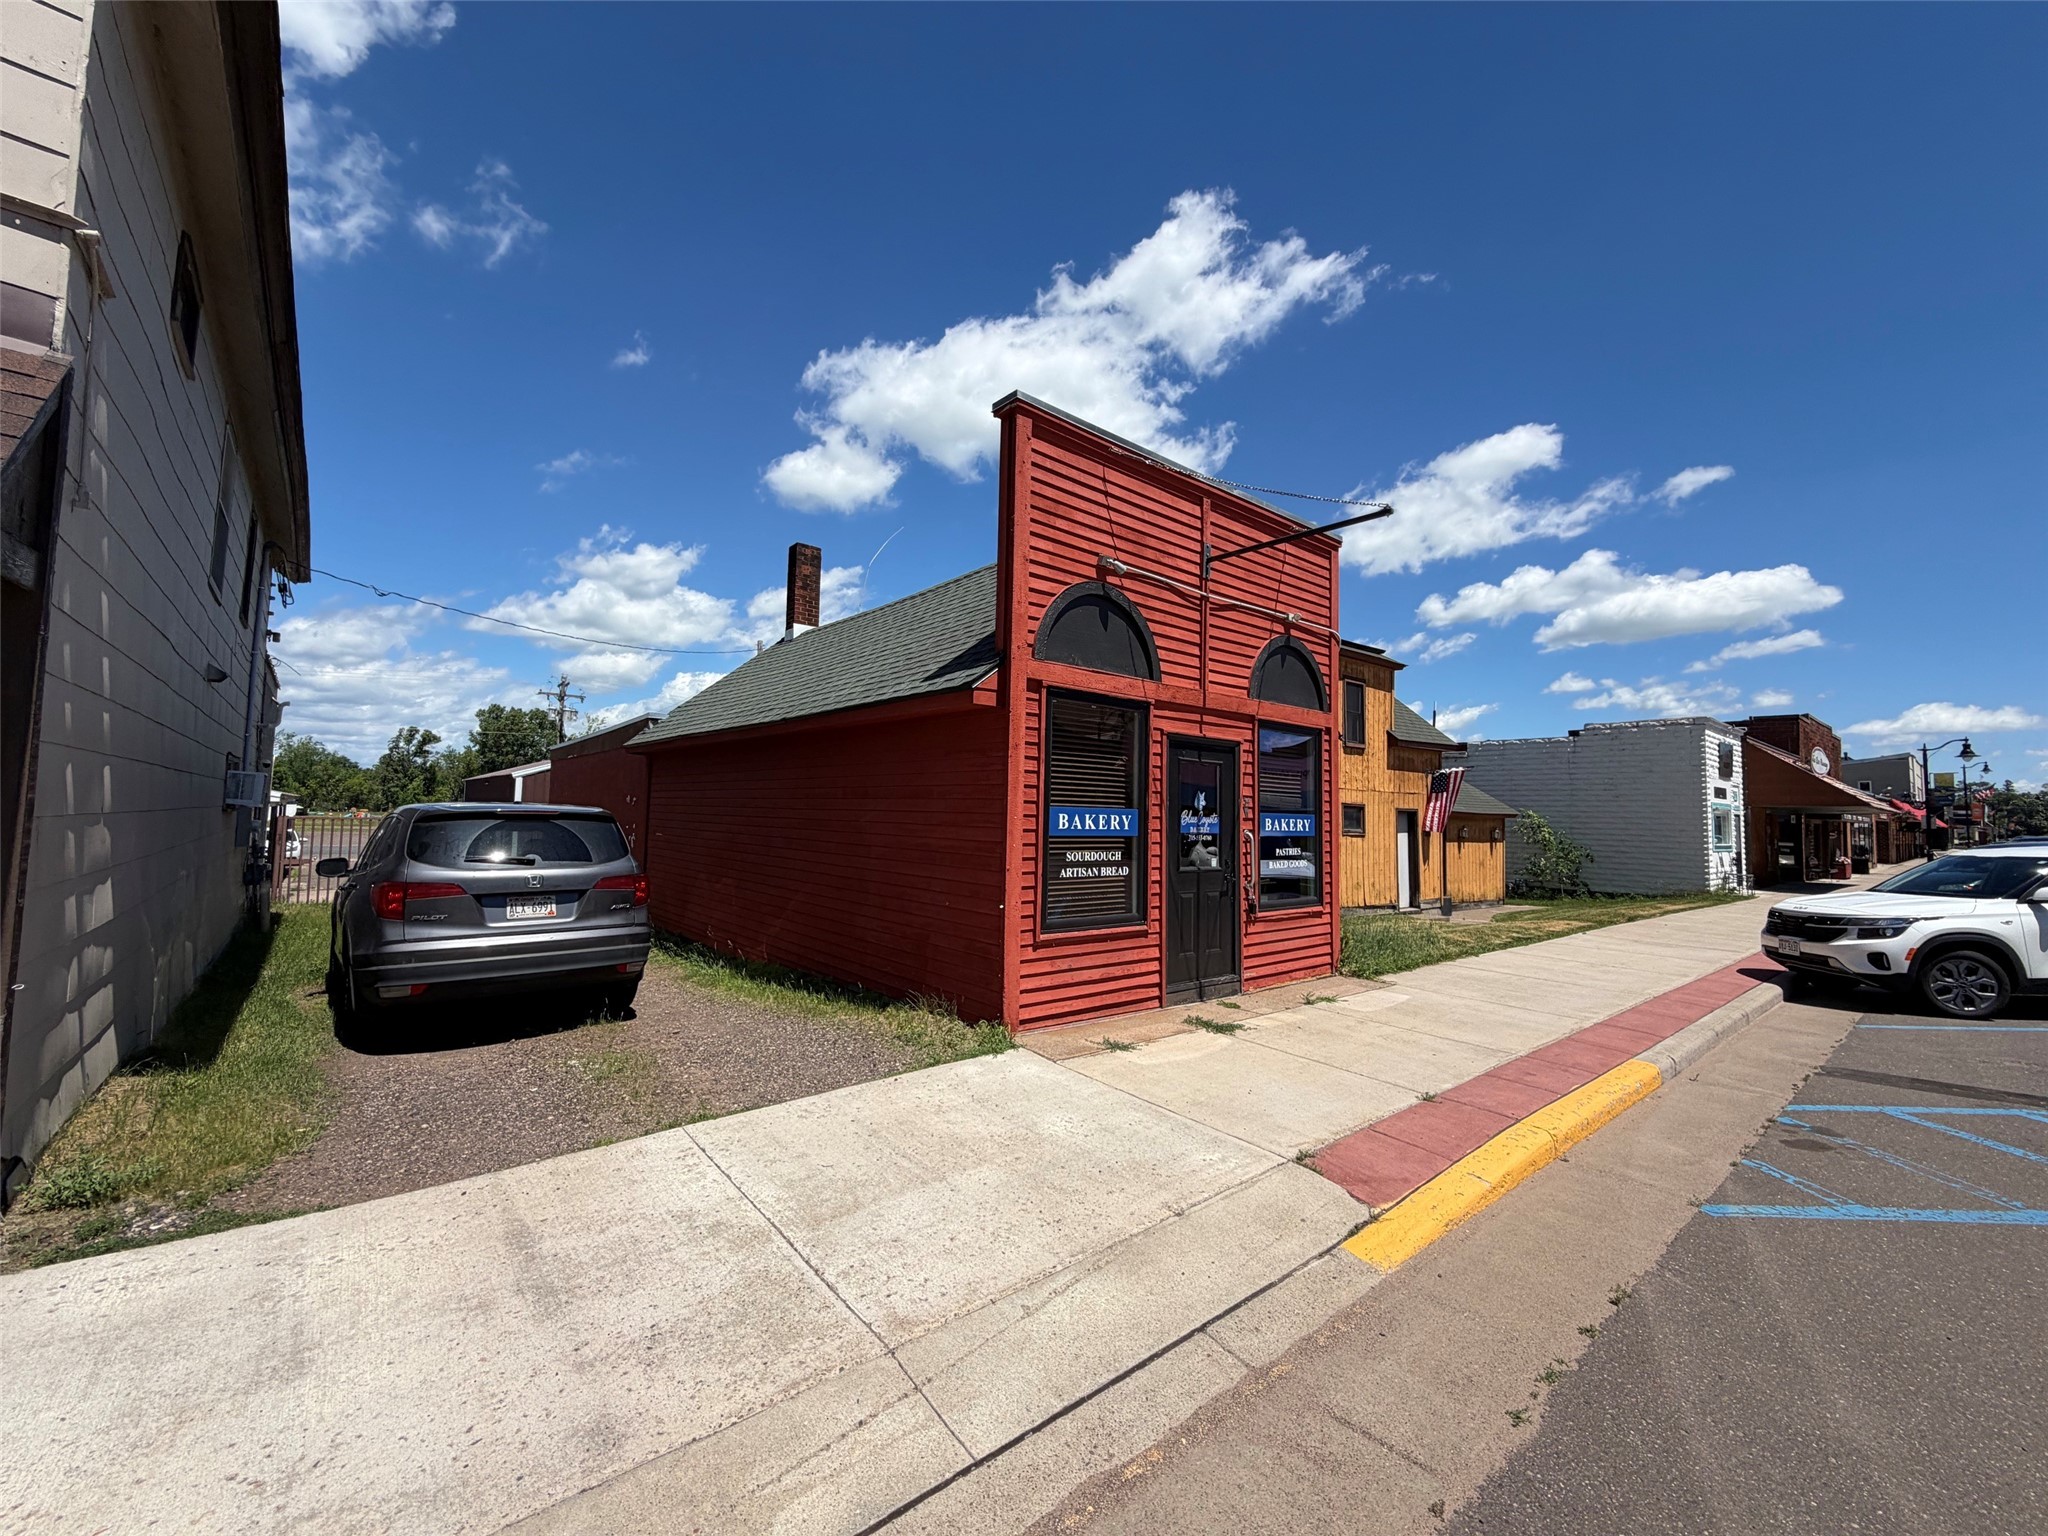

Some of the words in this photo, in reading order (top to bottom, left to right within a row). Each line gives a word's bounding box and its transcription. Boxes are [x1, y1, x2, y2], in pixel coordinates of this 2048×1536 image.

[1058, 813, 1132, 830] BAKERY
[1180, 809, 1198, 826] Blue
[1265, 818, 1311, 832] BAKERY
[1065, 850, 1122, 862] SOURDOUGH
[1275, 847, 1301, 857] PASTRIES
[1268, 860, 1288, 869] BAKED
[1289, 859, 1308, 868] GOODS
[1059, 867, 1099, 878] ARTISAN
[1100, 866, 1129, 876] BREAD
